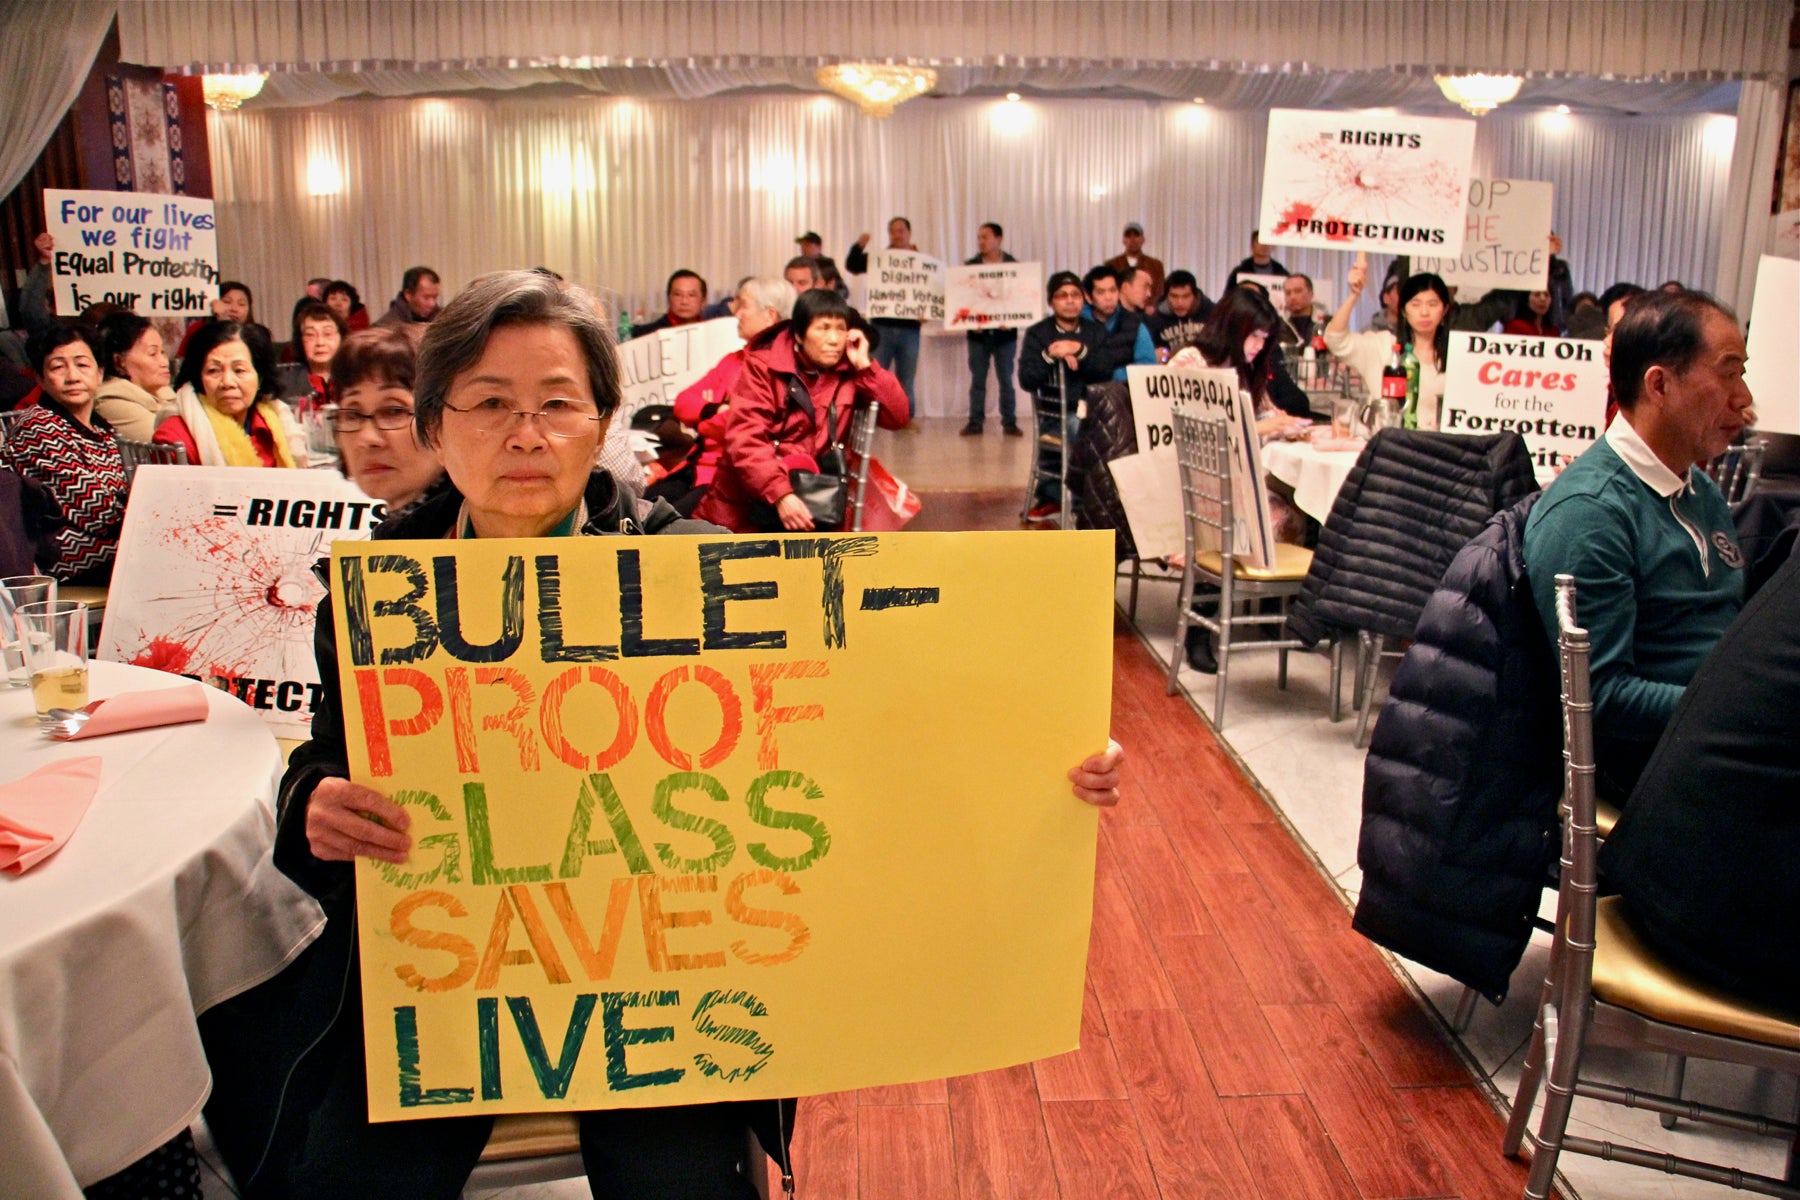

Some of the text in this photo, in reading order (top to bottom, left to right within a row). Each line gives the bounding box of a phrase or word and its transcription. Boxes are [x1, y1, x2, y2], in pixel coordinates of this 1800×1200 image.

[1340, 130, 1421, 148] RIGHTS
[1468, 180, 1511, 210] OP
[61, 200, 215, 230] For our lives
[1465, 214, 1500, 242] HE
[81, 227, 192, 250] we fight
[1296, 218, 1445, 244] PROTECTIONS
[55, 251, 220, 285] Equal Protection
[1414, 244, 1542, 275] INJUSTICE
[978, 271, 1016, 279] RIGHTS
[71, 283, 208, 312] is our right
[960, 312, 1033, 322] PROTECTIONS
[1467, 336, 1593, 362] David Oh
[1478, 361, 1577, 391] Cares
[1145, 374, 1236, 422] Protection
[1495, 393, 1554, 413] for the
[1447, 408, 1597, 440] Forgotten
[247, 498, 387, 531] RIGHTS
[341, 536, 939, 666] BULLET-
[353, 660, 830, 777] PROOF
[368, 770, 832, 889] GLASS
[389, 869, 811, 993] SAVES
[393, 988, 775, 1108] LIVES
